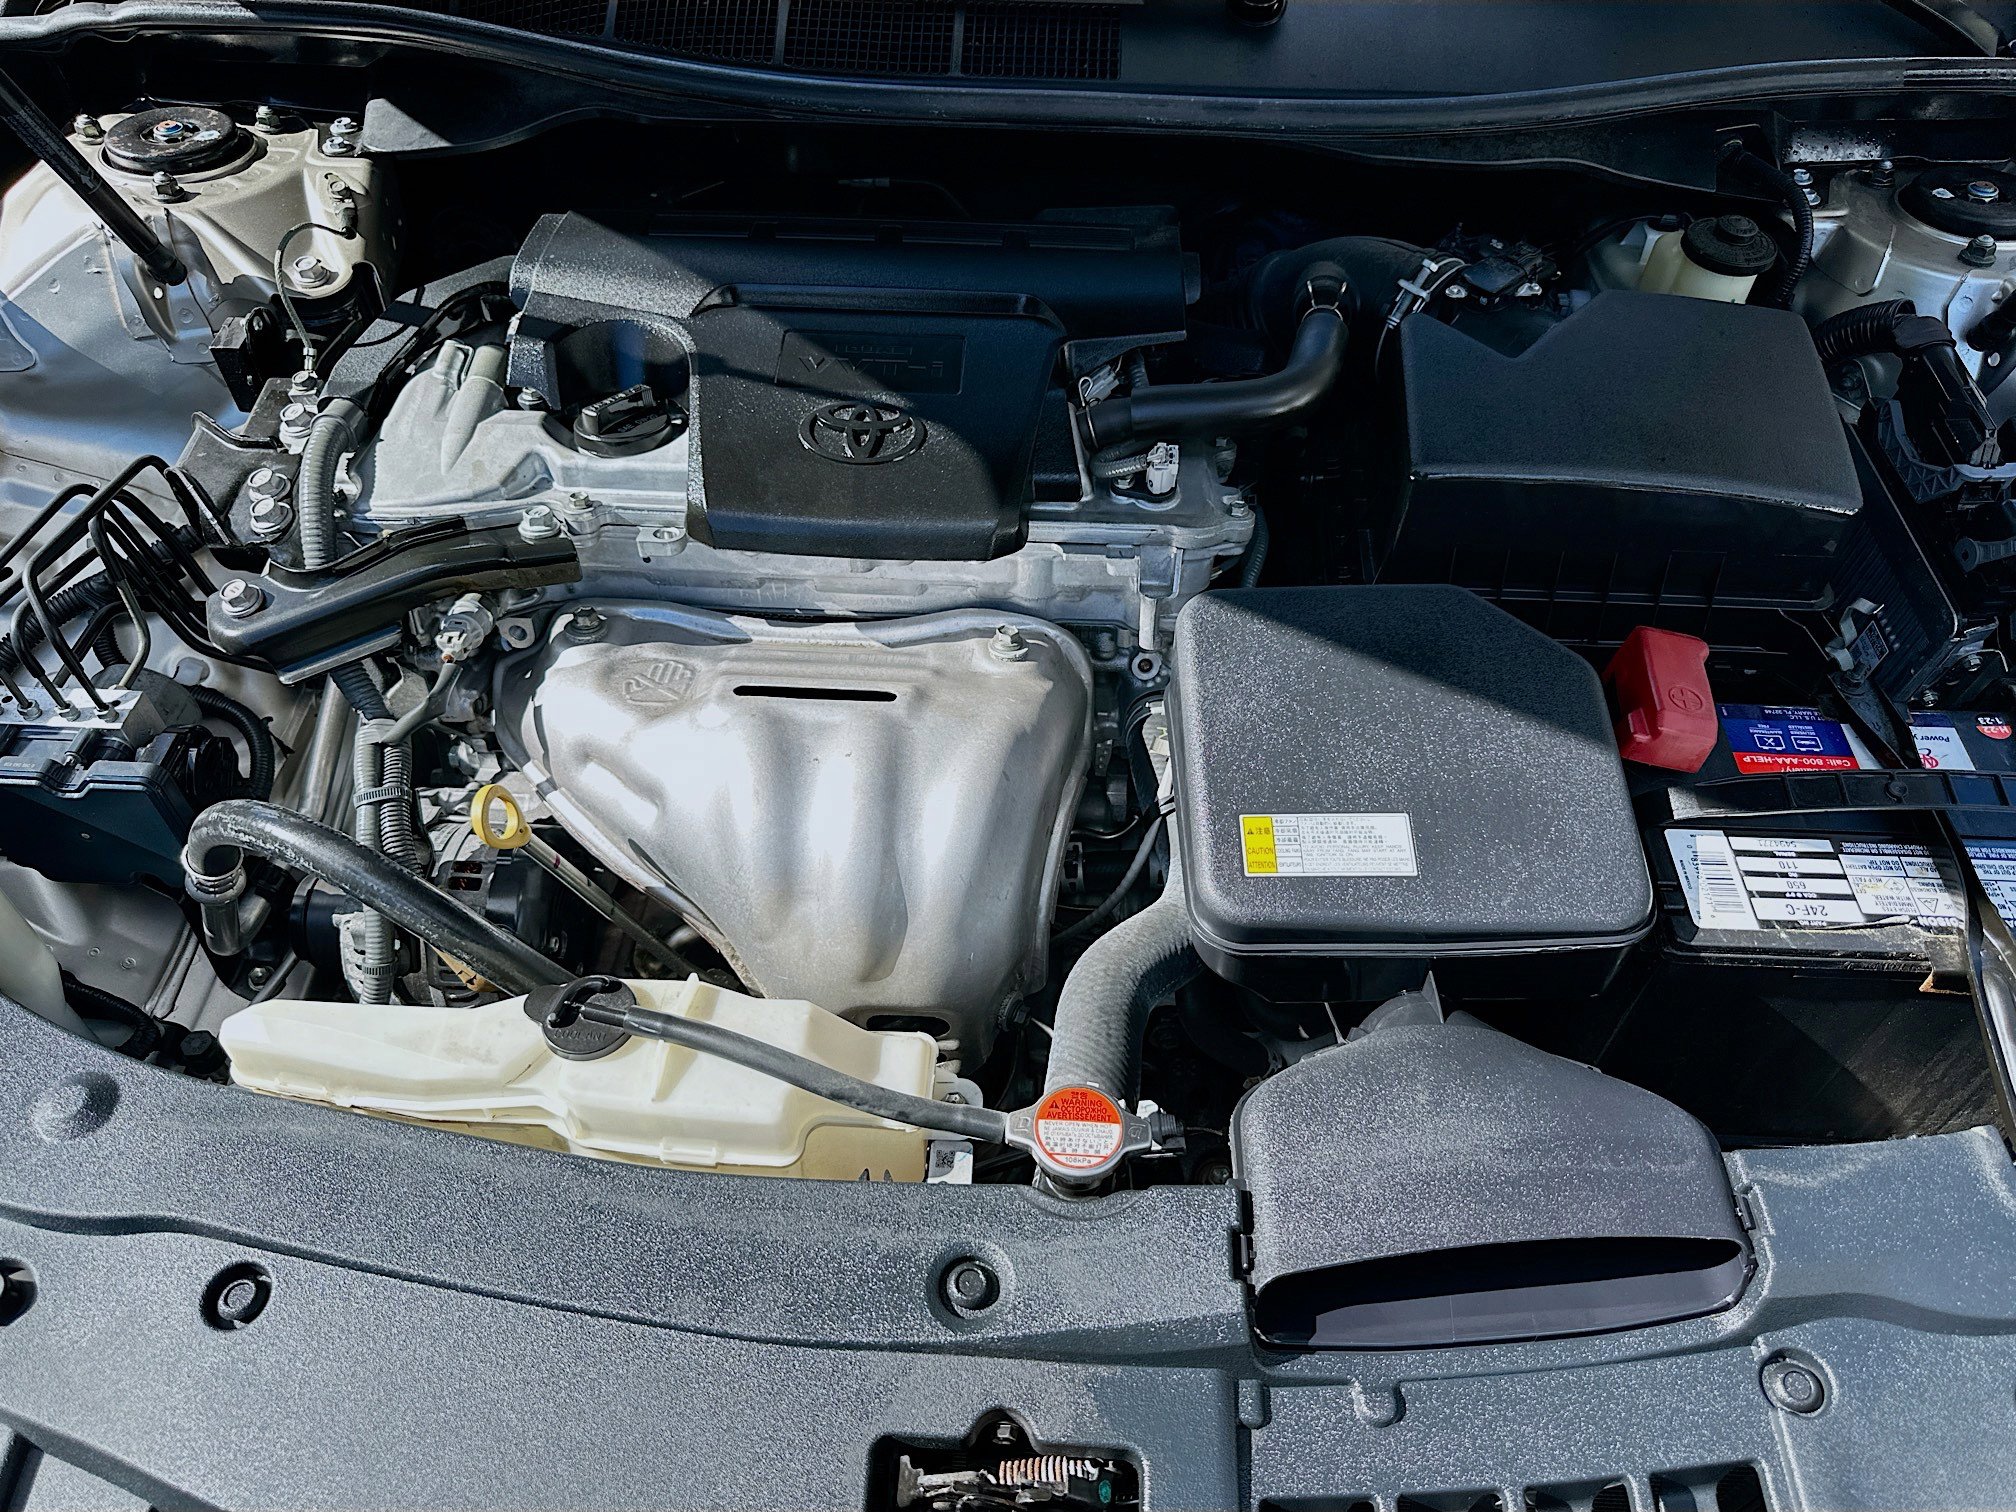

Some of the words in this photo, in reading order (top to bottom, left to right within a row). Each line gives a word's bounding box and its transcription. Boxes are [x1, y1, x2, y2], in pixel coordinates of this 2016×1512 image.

[1920, 735, 1950, 743] Power
[1742, 755, 1824, 766] 800-AAA-HELP
[1825, 758, 1851, 767] Call:
[1247, 847, 1274, 855] CAUTION
[1248, 861, 1276, 869] ATTENTION
[1778, 860, 1799, 870] 110
[1786, 880, 1806, 890] 650
[1785, 903, 1828, 917] 24F-C
[554, 1029, 607, 1041] COOLANT
[1060, 1098, 1103, 1108] WARNING
[1060, 1105, 1108, 1115] ОСТОРОЖНО
[1046, 1111, 1112, 1122] AVERTISSEMENT
[1065, 1156, 1092, 1165] 108kPa
